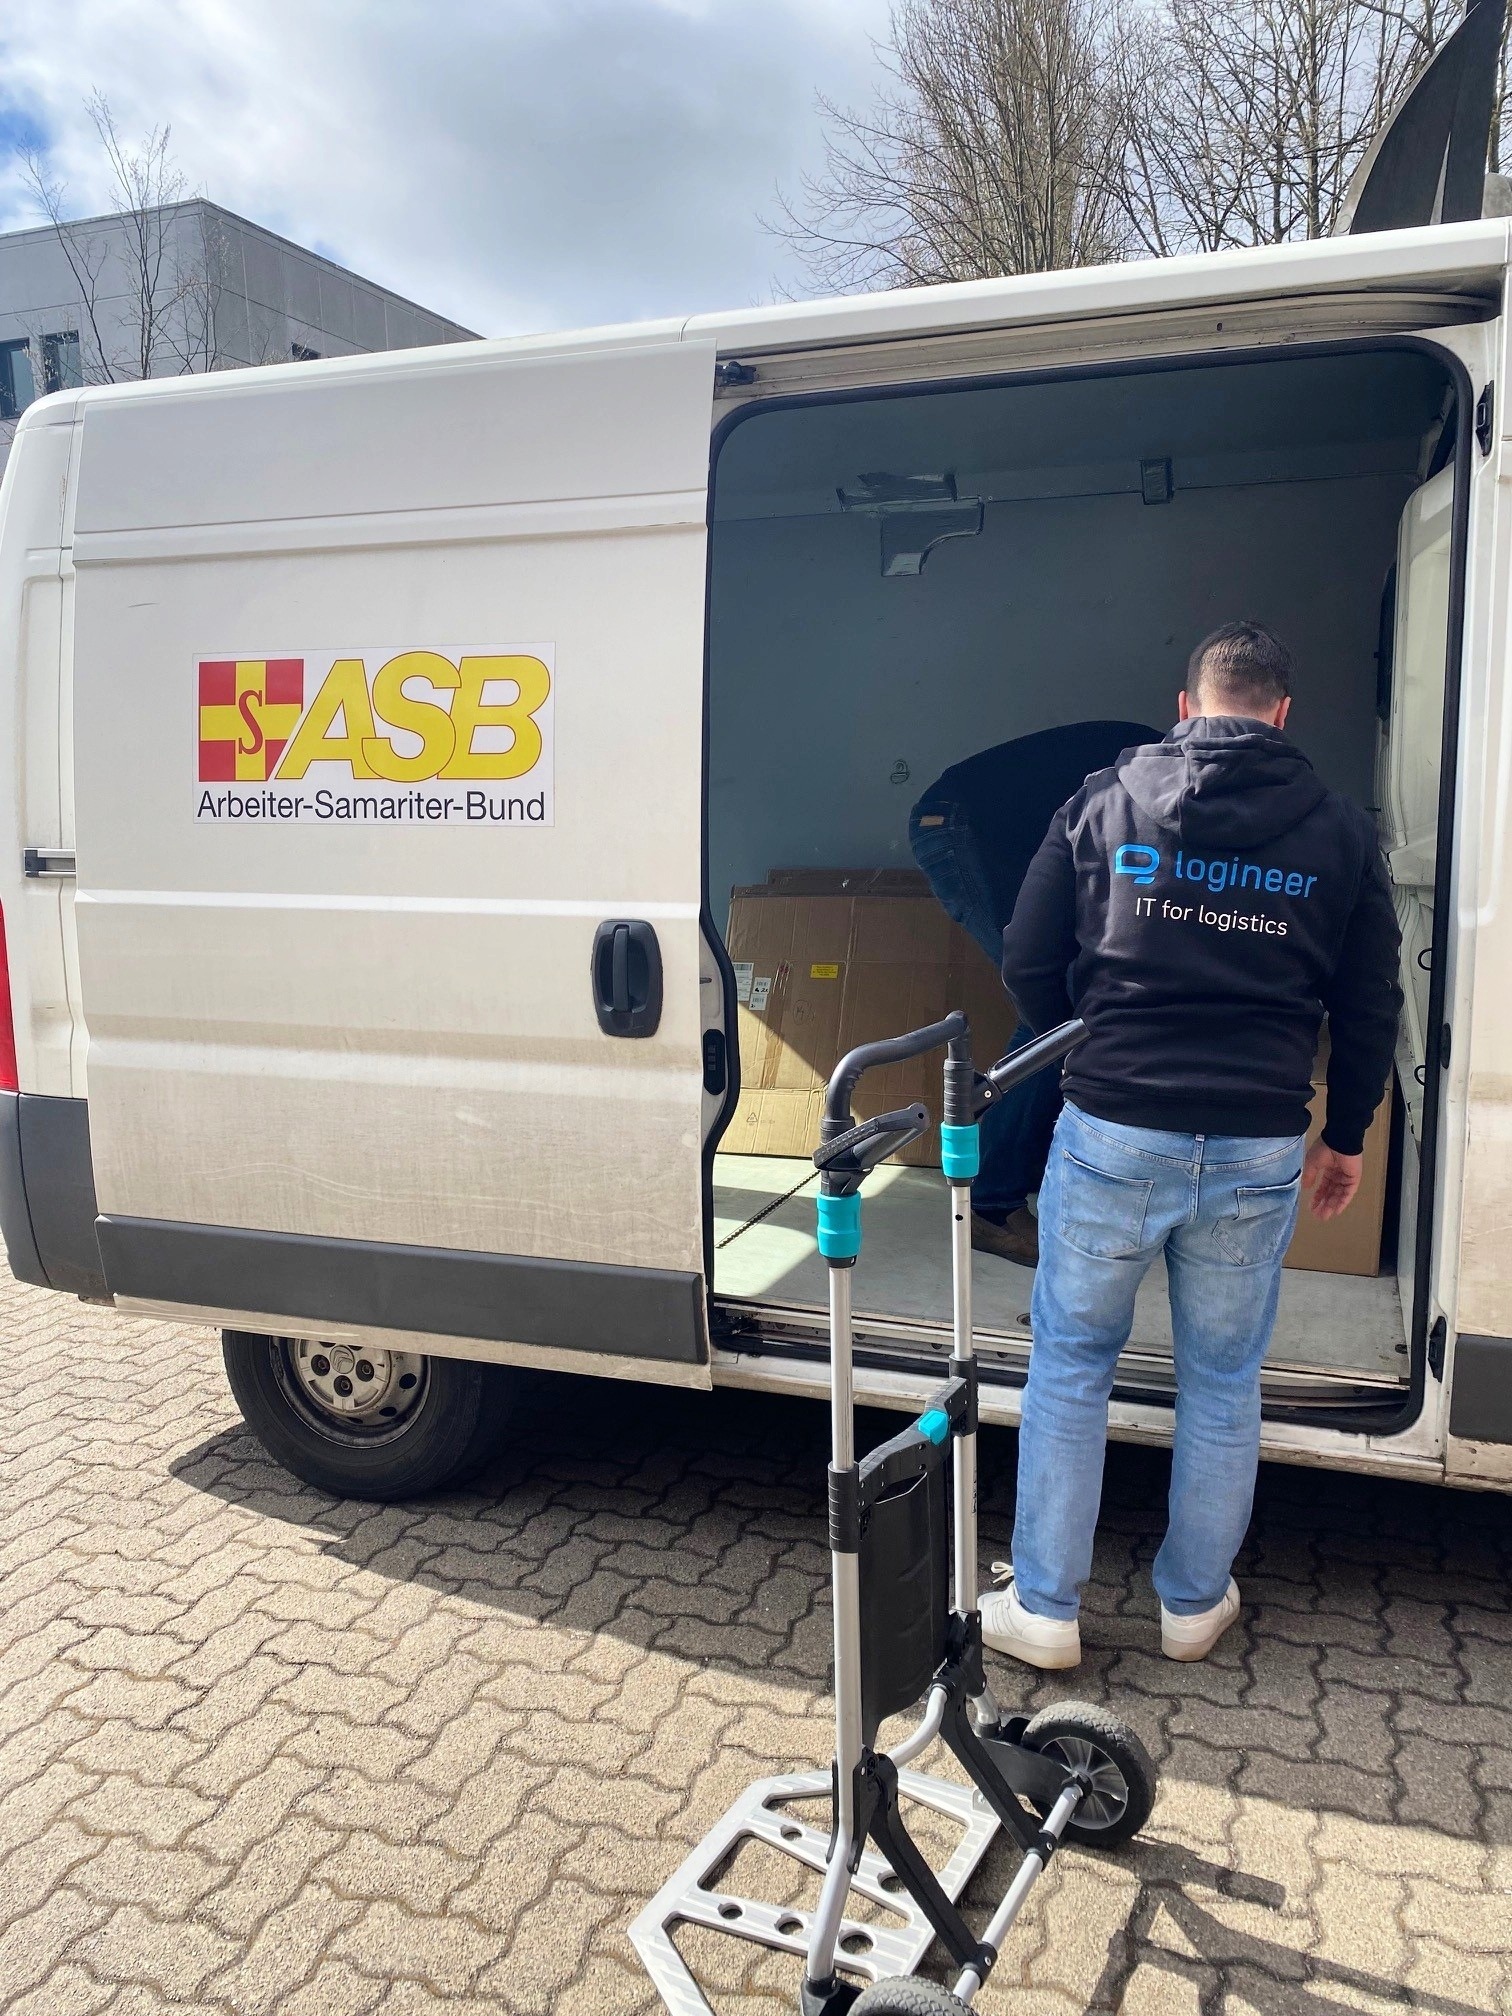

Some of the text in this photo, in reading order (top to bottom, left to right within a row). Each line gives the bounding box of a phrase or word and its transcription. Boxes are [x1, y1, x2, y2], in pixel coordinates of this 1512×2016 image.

[238, 690, 263, 754] S
[275, 651, 550, 782] ASB
[197, 790, 545, 820] Arbeiter-Samariter-Bund
[1175, 850, 1318, 898] logineer
[1136, 897, 1288, 936] IT for logistics
